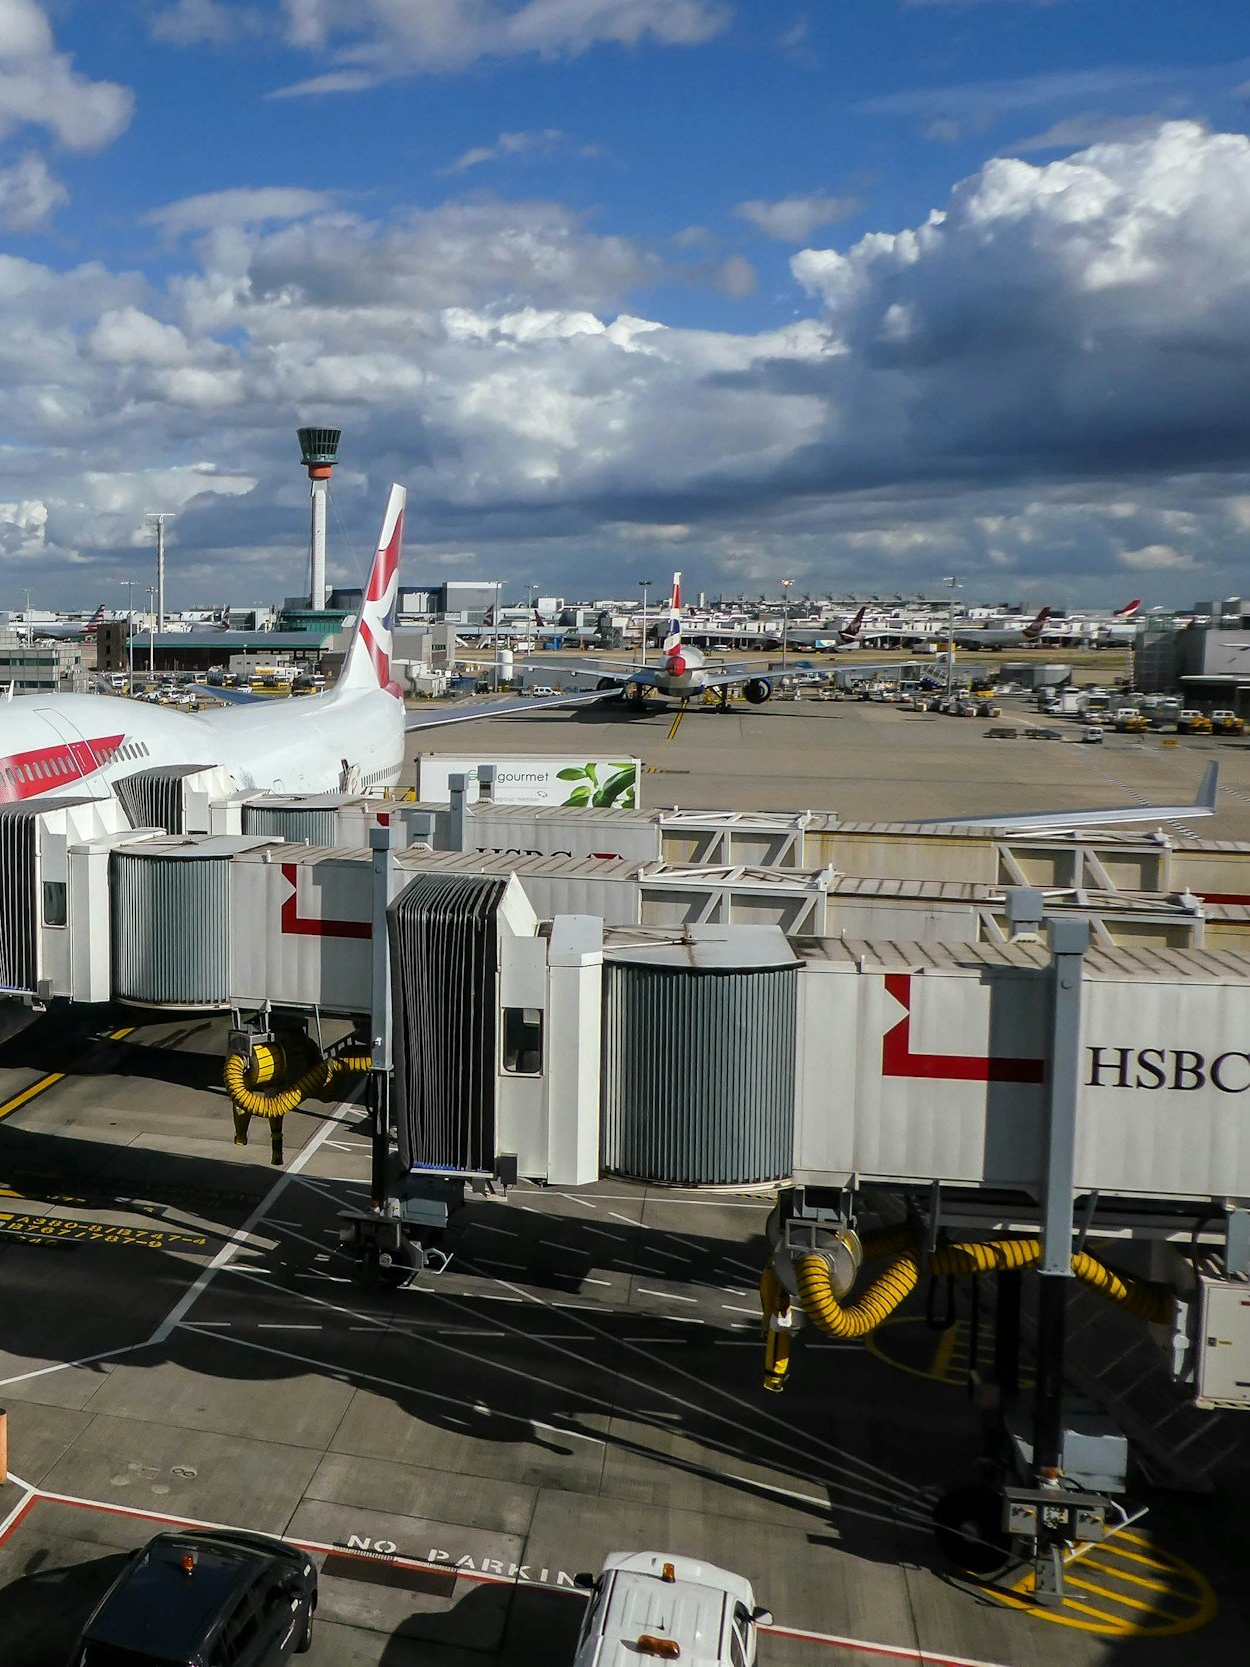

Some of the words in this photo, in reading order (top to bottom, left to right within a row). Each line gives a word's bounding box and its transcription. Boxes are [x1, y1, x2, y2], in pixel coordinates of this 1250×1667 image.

[1084, 1046, 1250, 1094] HSBC
[347, 1534, 398, 1554] NO
[427, 1548, 577, 1587] PARKIN
